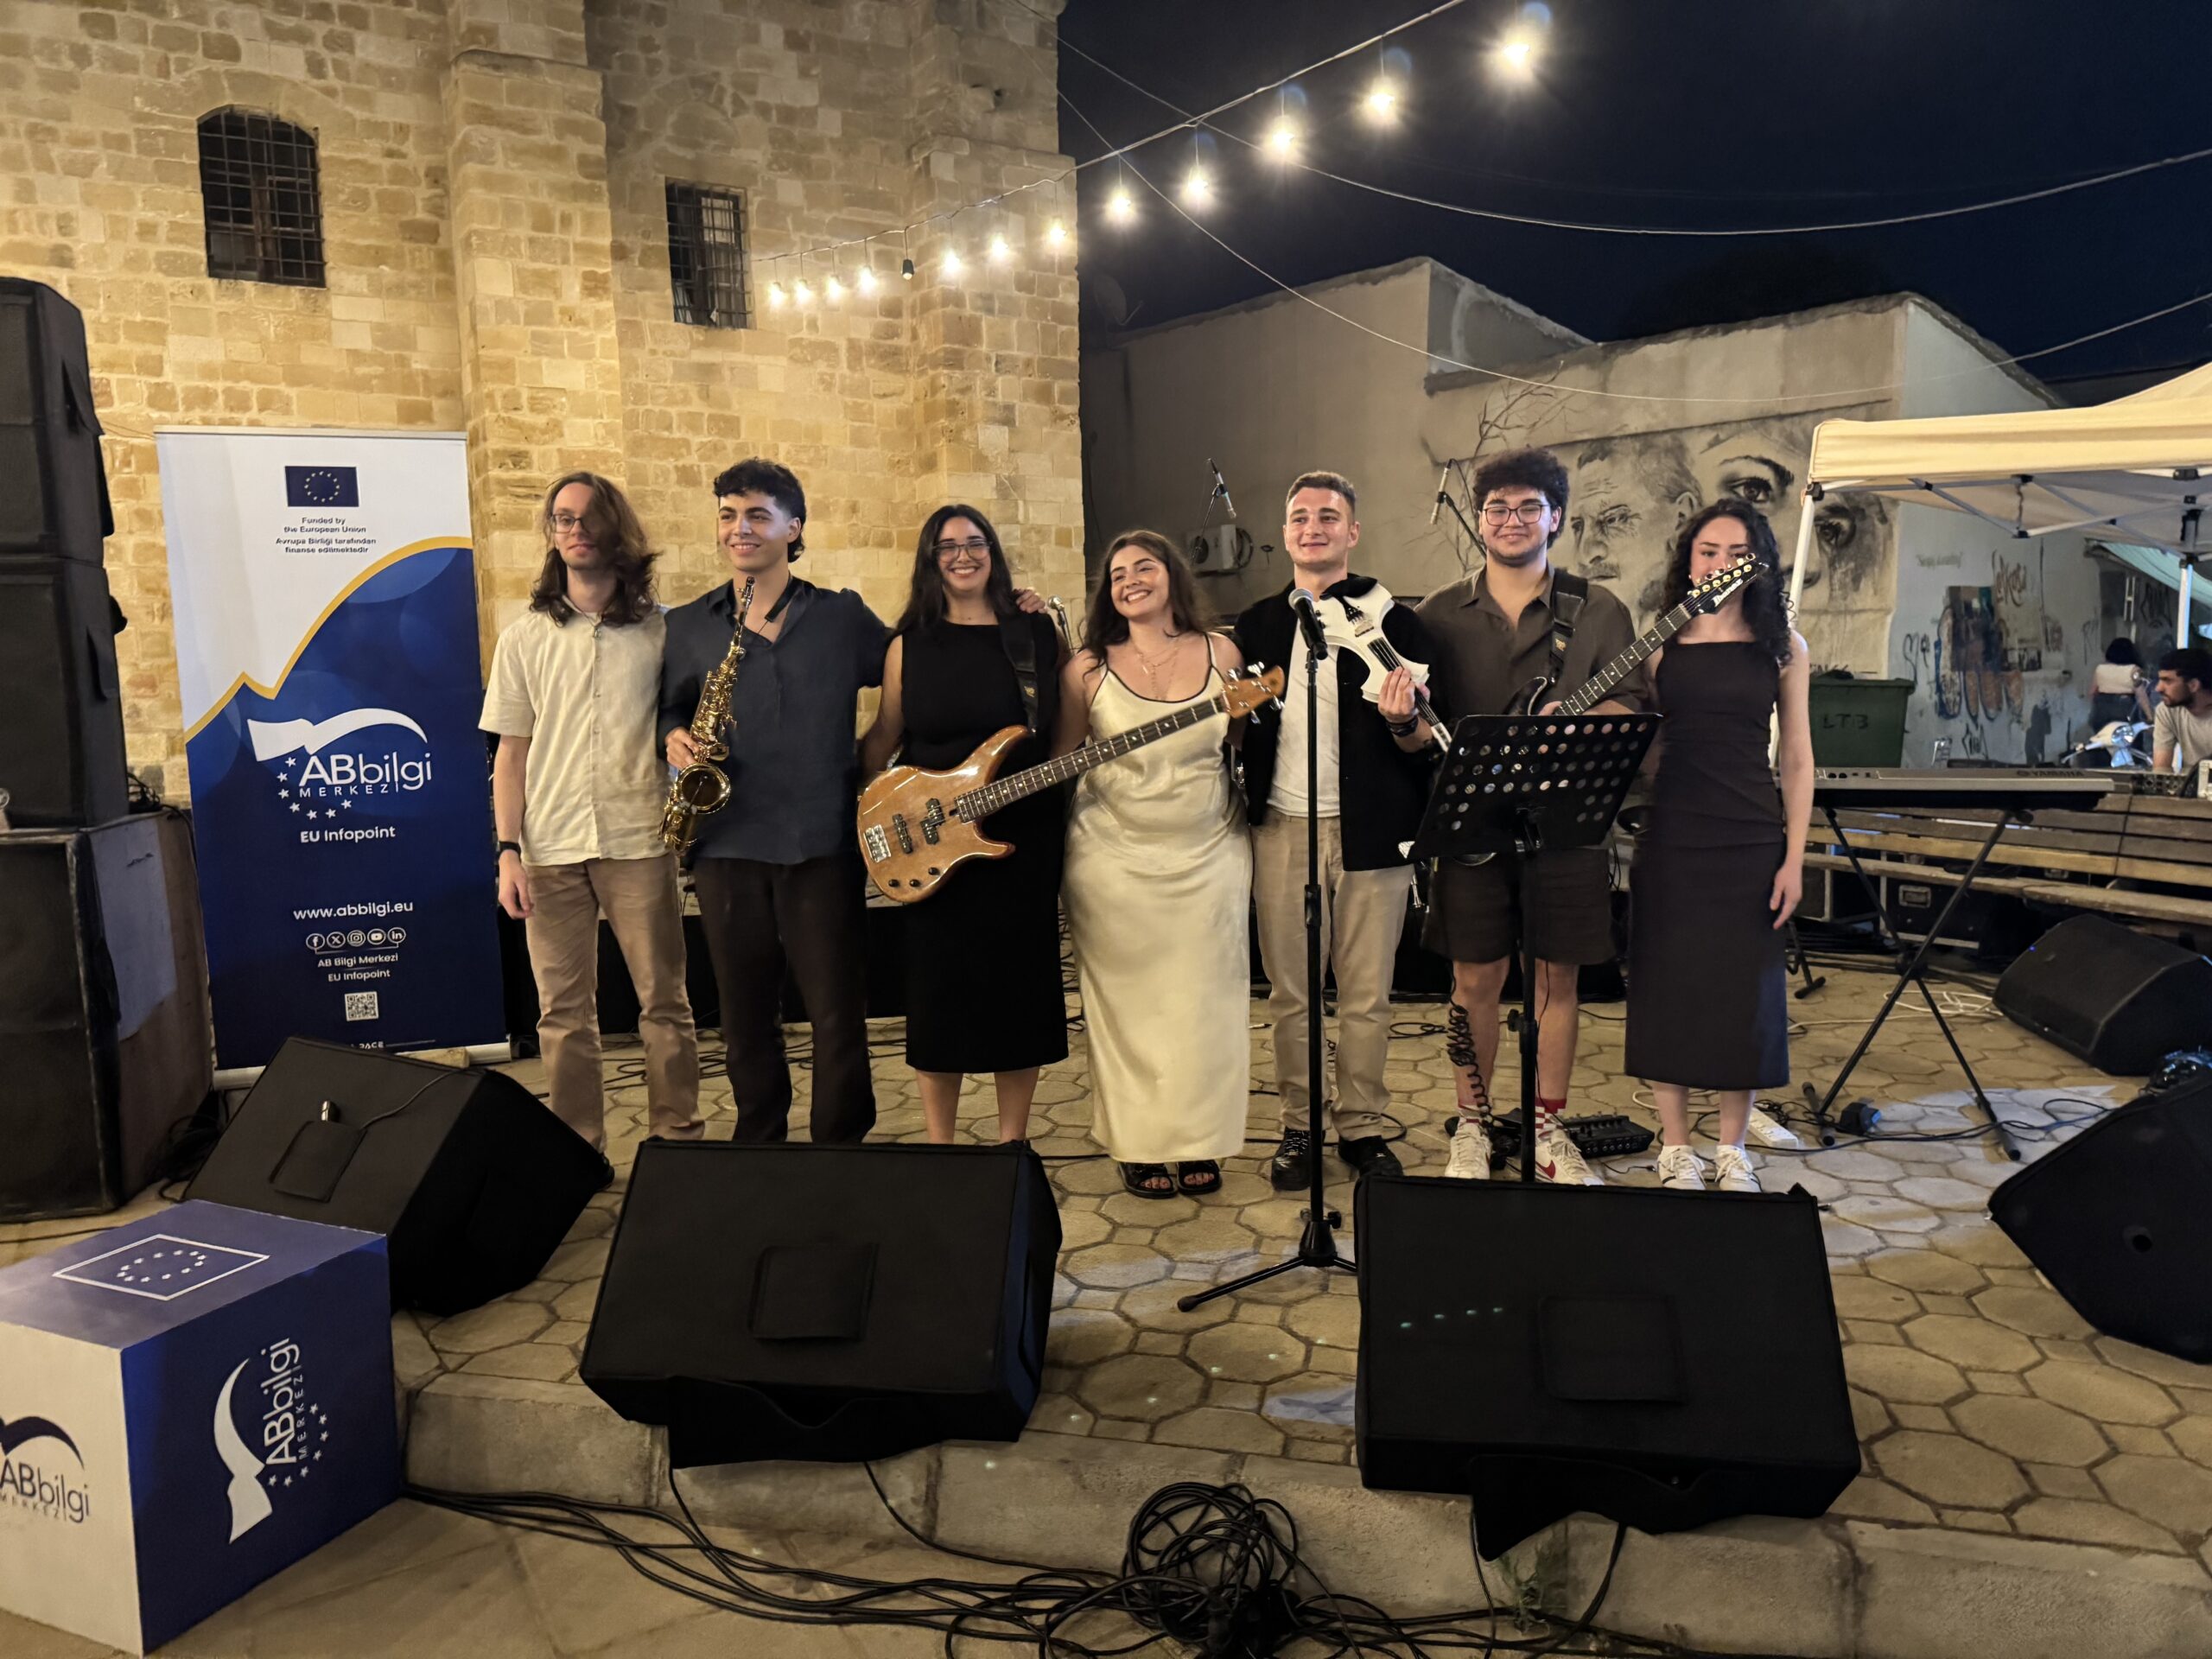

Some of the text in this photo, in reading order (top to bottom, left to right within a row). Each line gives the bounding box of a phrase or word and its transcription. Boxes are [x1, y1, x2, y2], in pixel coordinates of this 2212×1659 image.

[335, 517, 346, 525] by
[300, 826, 397, 843] EU Infopoint
[293, 901, 414, 920] www.abbilgi.eu
[317, 953, 398, 968] AB Bilgi Merkezi
[328, 969, 391, 982] EU Infopoint
